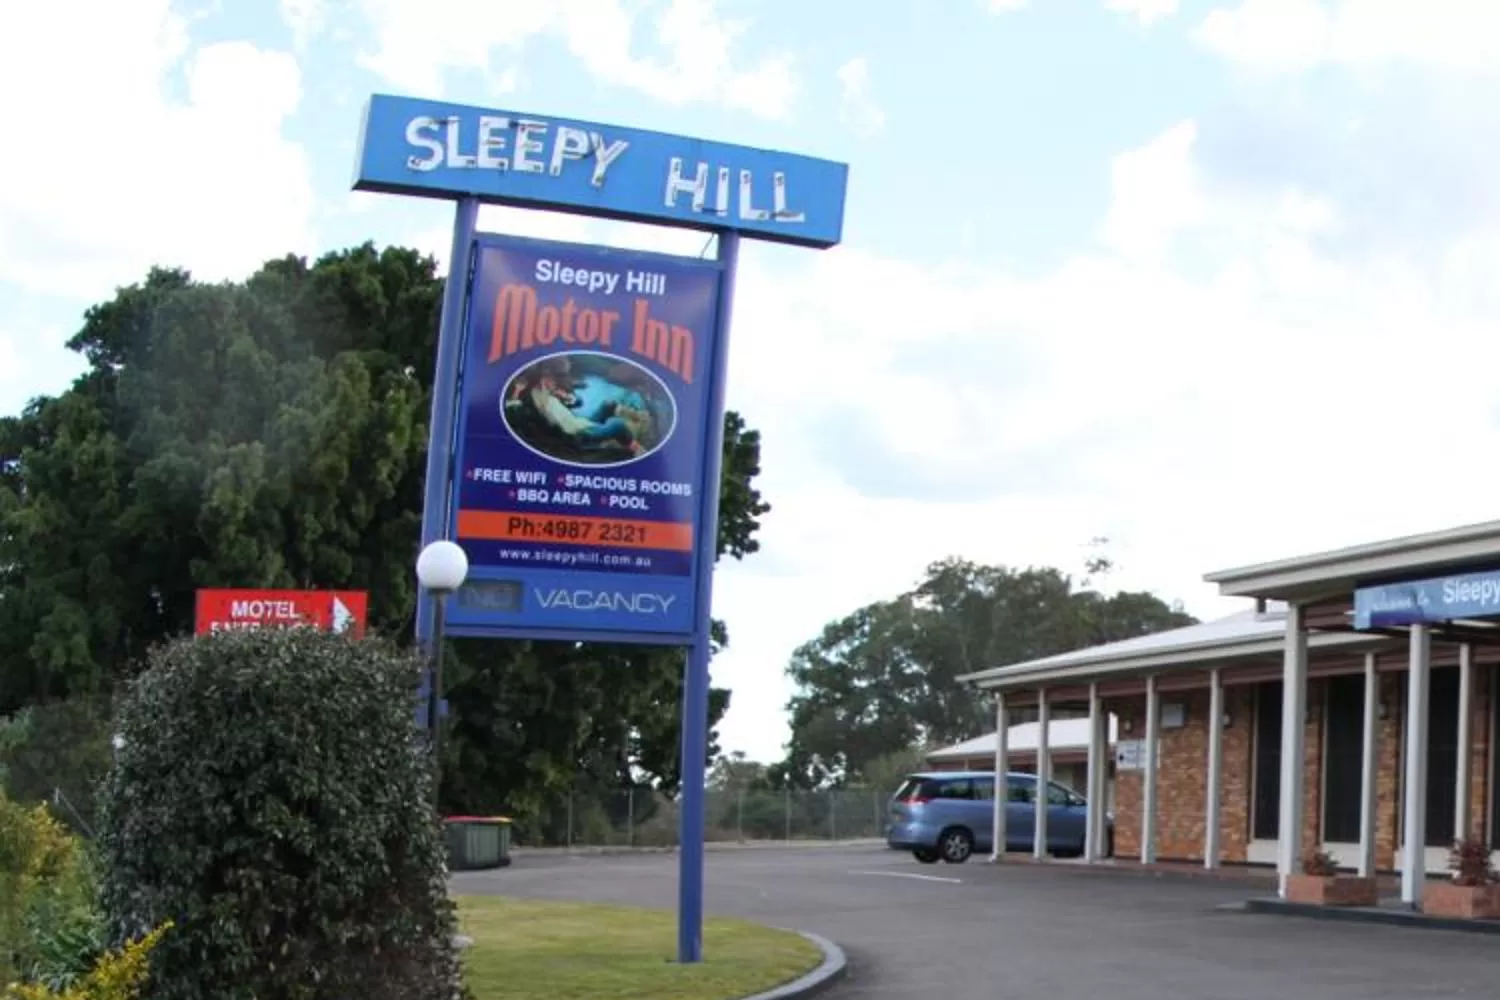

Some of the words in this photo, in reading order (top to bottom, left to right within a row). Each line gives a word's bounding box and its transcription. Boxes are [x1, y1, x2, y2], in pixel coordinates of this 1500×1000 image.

[406, 114, 629, 187] SLEEPY
[664, 157, 806, 223] HILL
[535, 259, 621, 295] Sleepy
[626, 271, 666, 296] Hill
[488, 283, 621, 364] Motor
[631, 297, 695, 385] Inn
[474, 468, 512, 484] FREE
[515, 471, 547, 486] WIFI
[565, 474, 637, 493] SPACIOUS
[641, 480, 692, 496] ROOMS
[517, 490, 549, 503] BBQ
[550, 491, 591, 506] AREA
[609, 496, 649, 510] POOL
[600, 523, 647, 543] 2321
[231, 600, 299, 619] MOTEL
[534, 587, 676, 614] VACANCY
